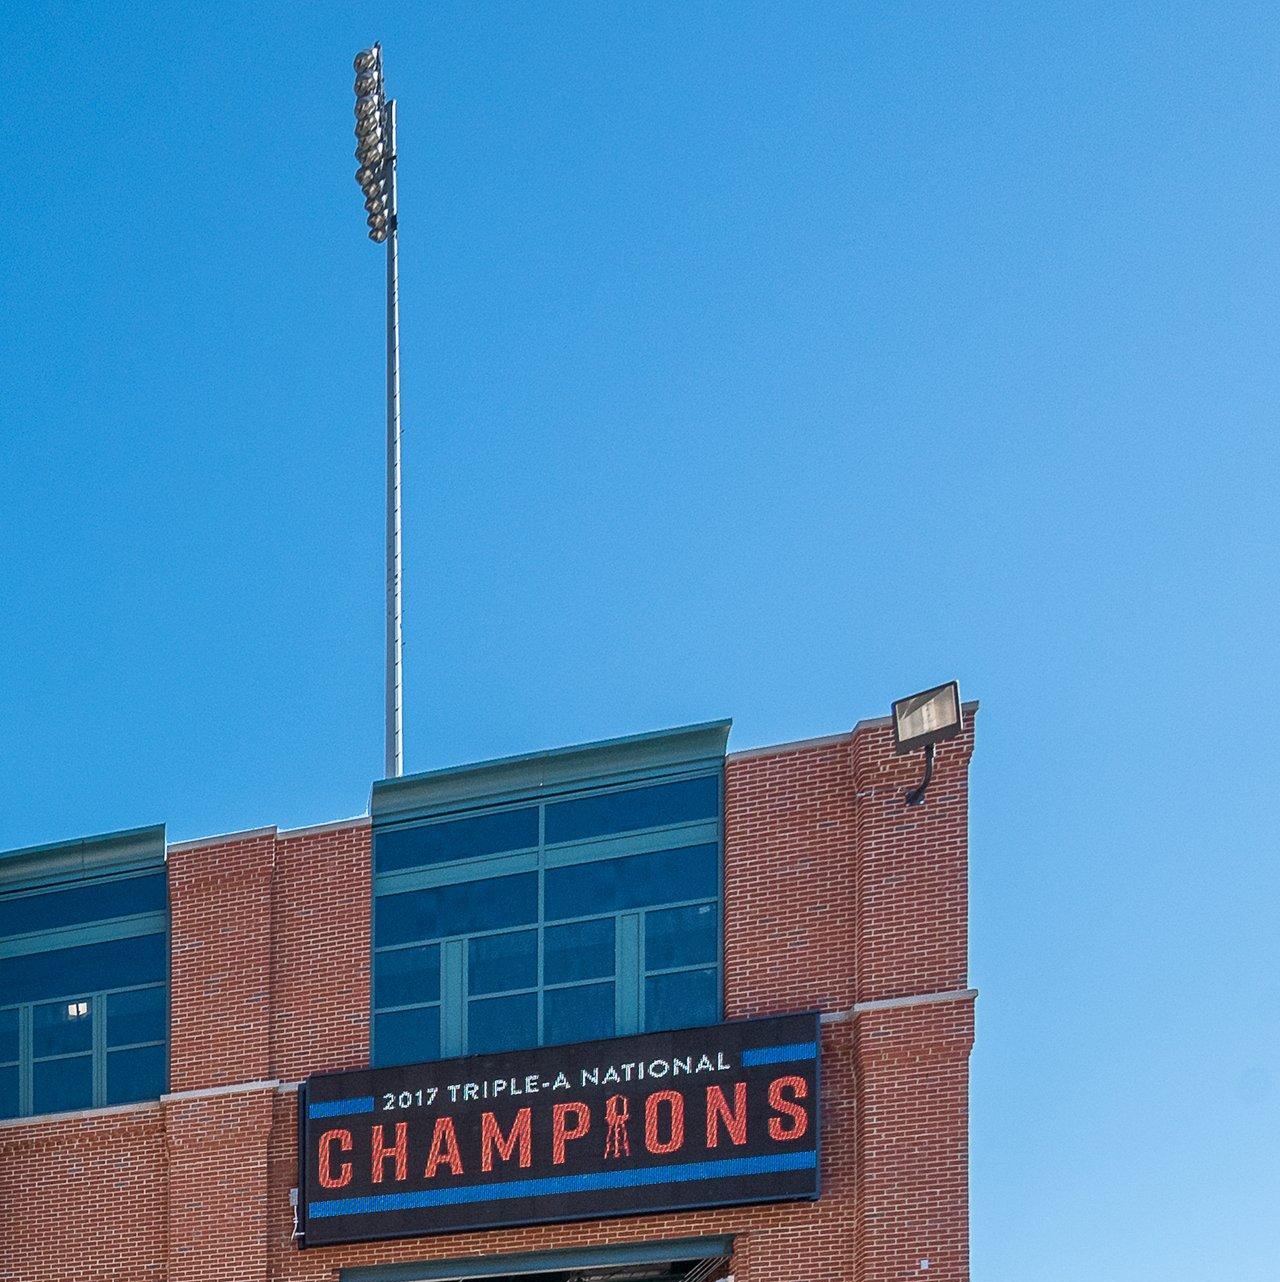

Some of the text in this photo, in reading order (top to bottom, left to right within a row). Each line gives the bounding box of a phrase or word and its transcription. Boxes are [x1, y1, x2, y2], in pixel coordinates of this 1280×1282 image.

[381, 1051, 731, 1111] 2017 TRIPLE-A NATIONAL
[318, 1074, 808, 1189] CHAMPIONS
